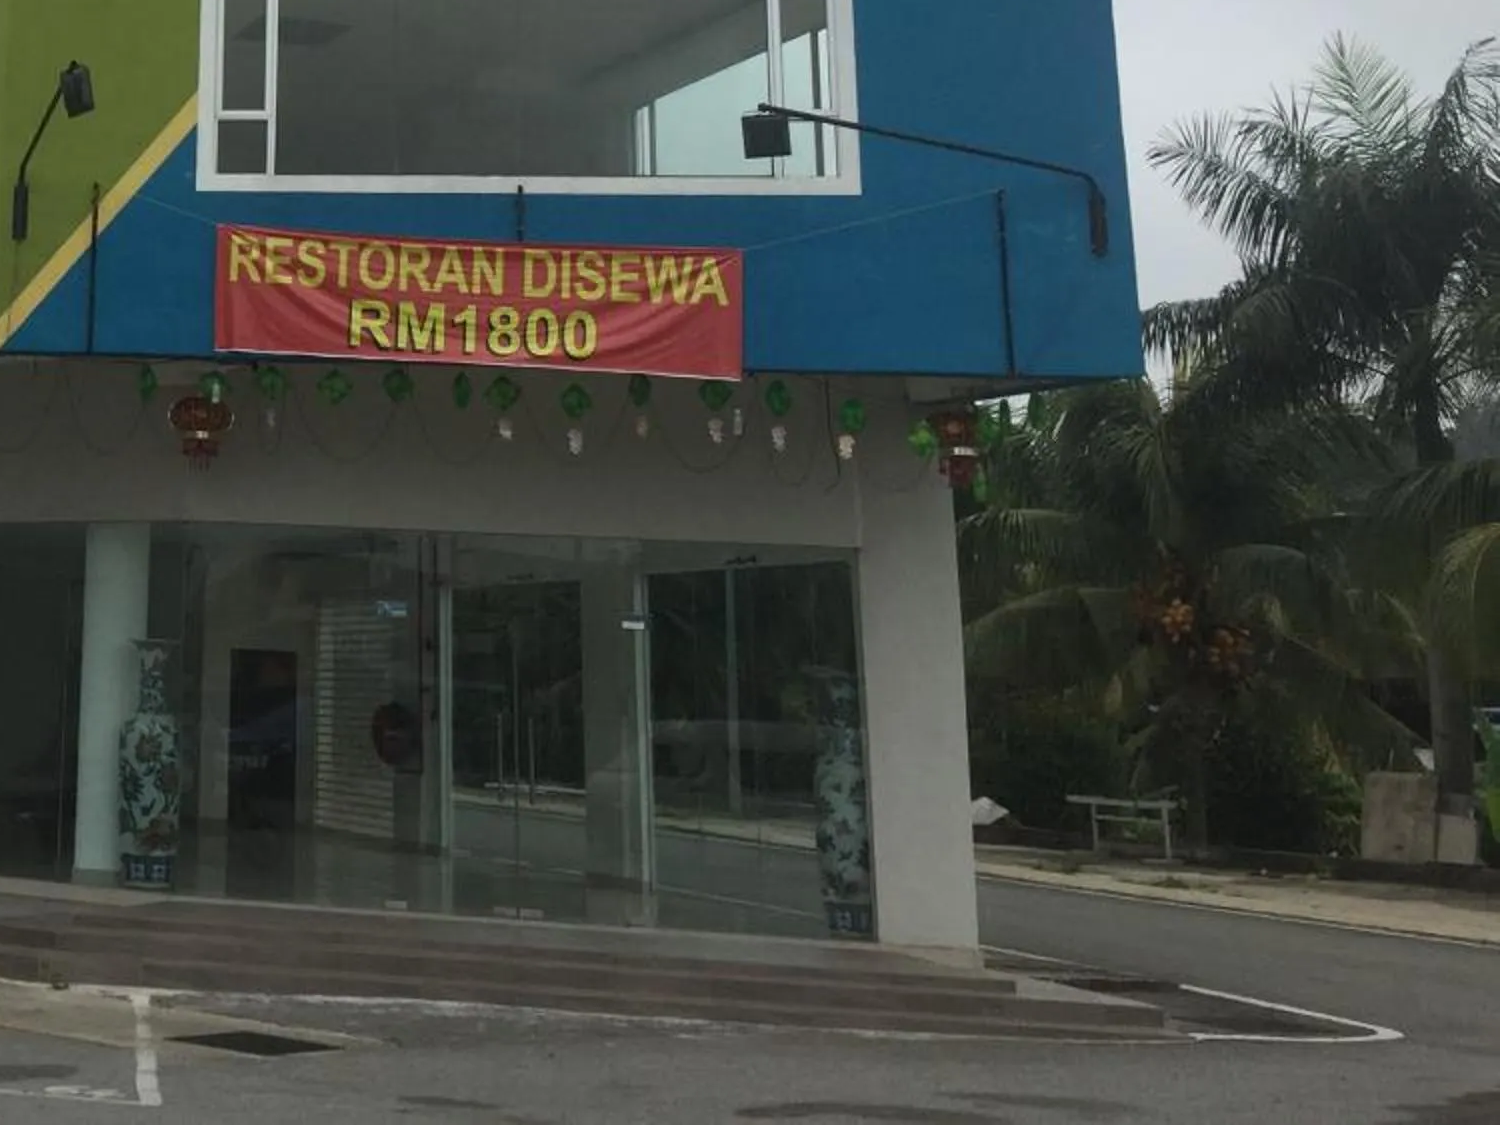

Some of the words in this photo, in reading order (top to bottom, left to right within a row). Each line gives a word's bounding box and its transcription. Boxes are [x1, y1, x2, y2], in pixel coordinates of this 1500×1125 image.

[229, 234, 505, 296] RESTORAN
[522, 249, 729, 307] DISEWA
[347, 299, 599, 360] RM1800
